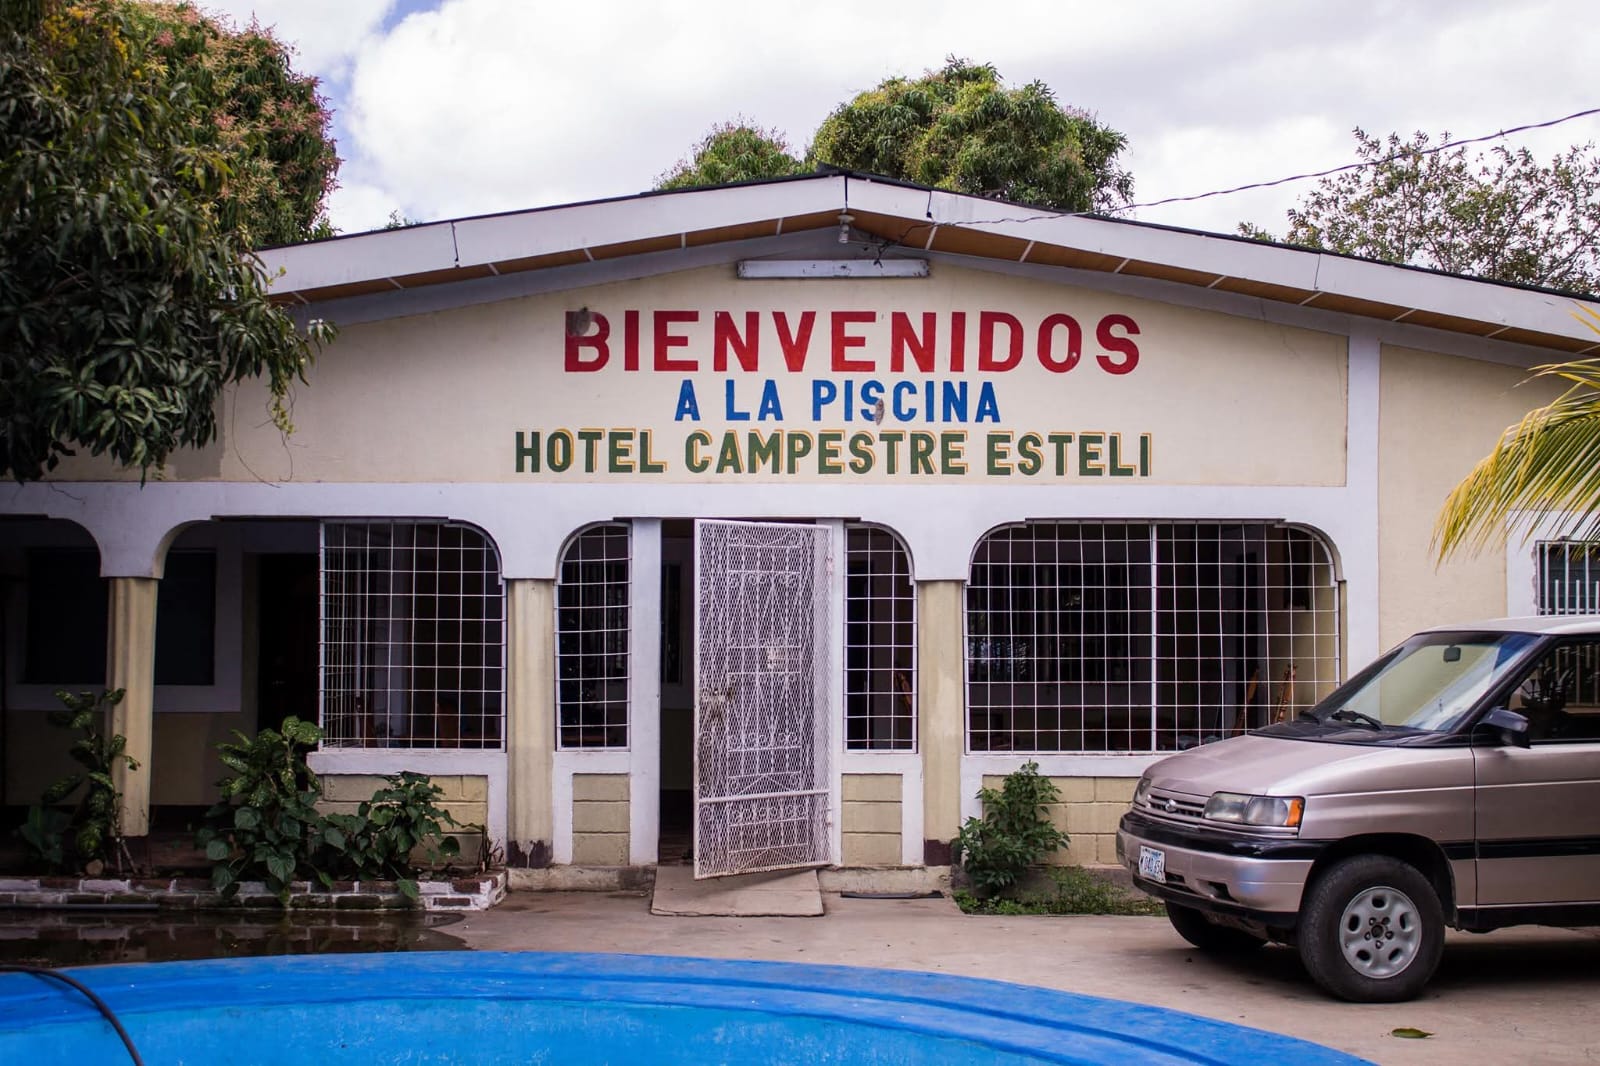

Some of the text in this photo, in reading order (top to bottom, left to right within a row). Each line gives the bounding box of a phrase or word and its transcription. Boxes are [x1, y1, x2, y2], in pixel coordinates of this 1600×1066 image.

[564, 310, 1140, 375] BIENVENIDOS
[674, 379, 1001, 423] A LA PISCINA
[515, 428, 1151, 477] HOTEL CAMPESTRE ESTELI
